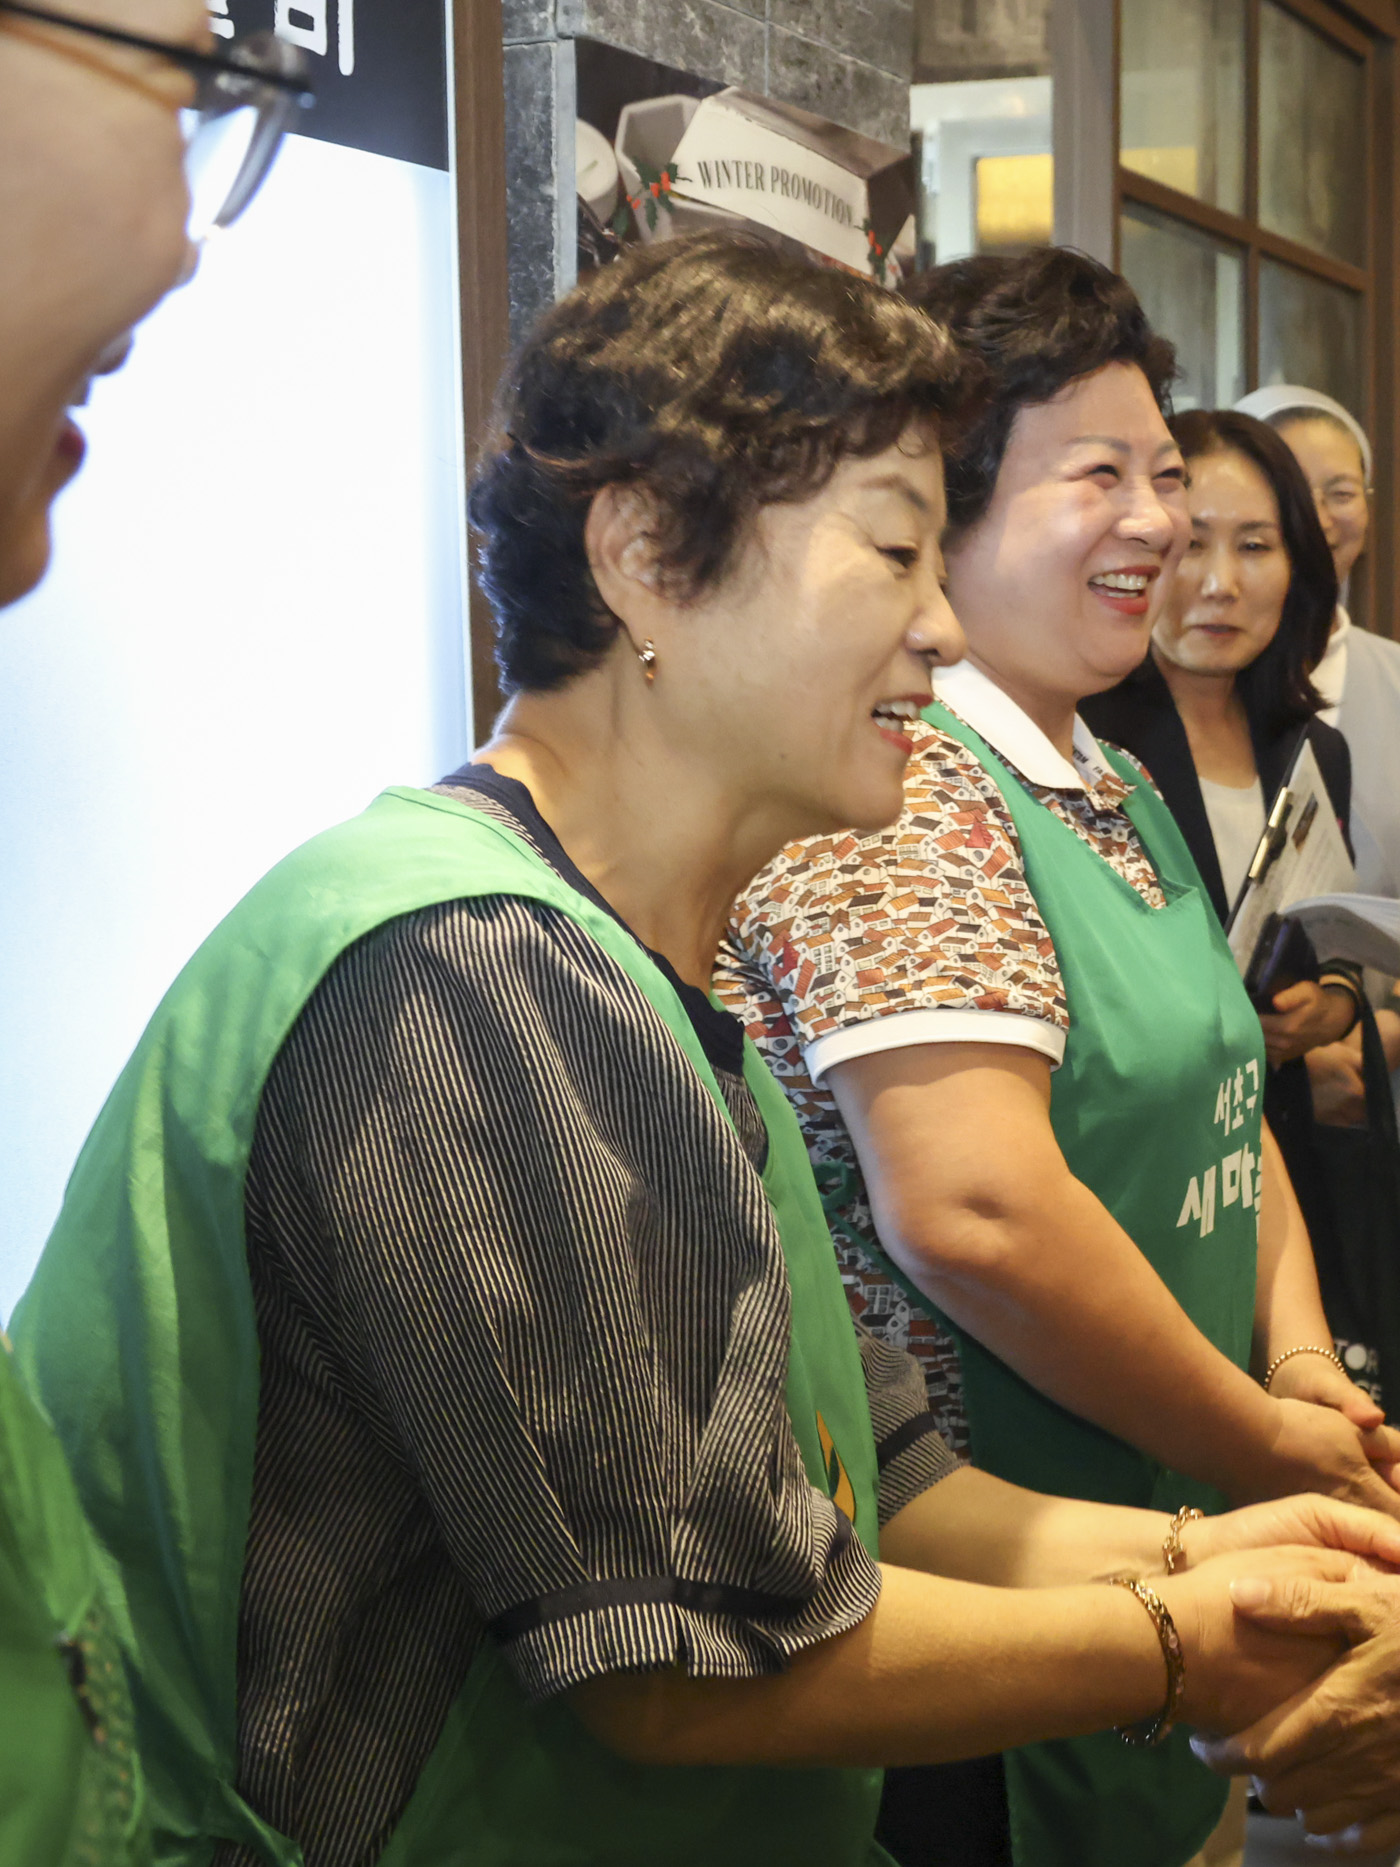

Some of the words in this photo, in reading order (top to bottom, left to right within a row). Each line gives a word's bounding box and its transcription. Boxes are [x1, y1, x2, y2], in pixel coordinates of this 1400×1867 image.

[697, 160, 765, 192] WINTER
[770, 165, 855, 227] PROMOTION
[1213, 1057, 1260, 1137] 서초구
[1175, 1141, 1263, 1242] 새마
